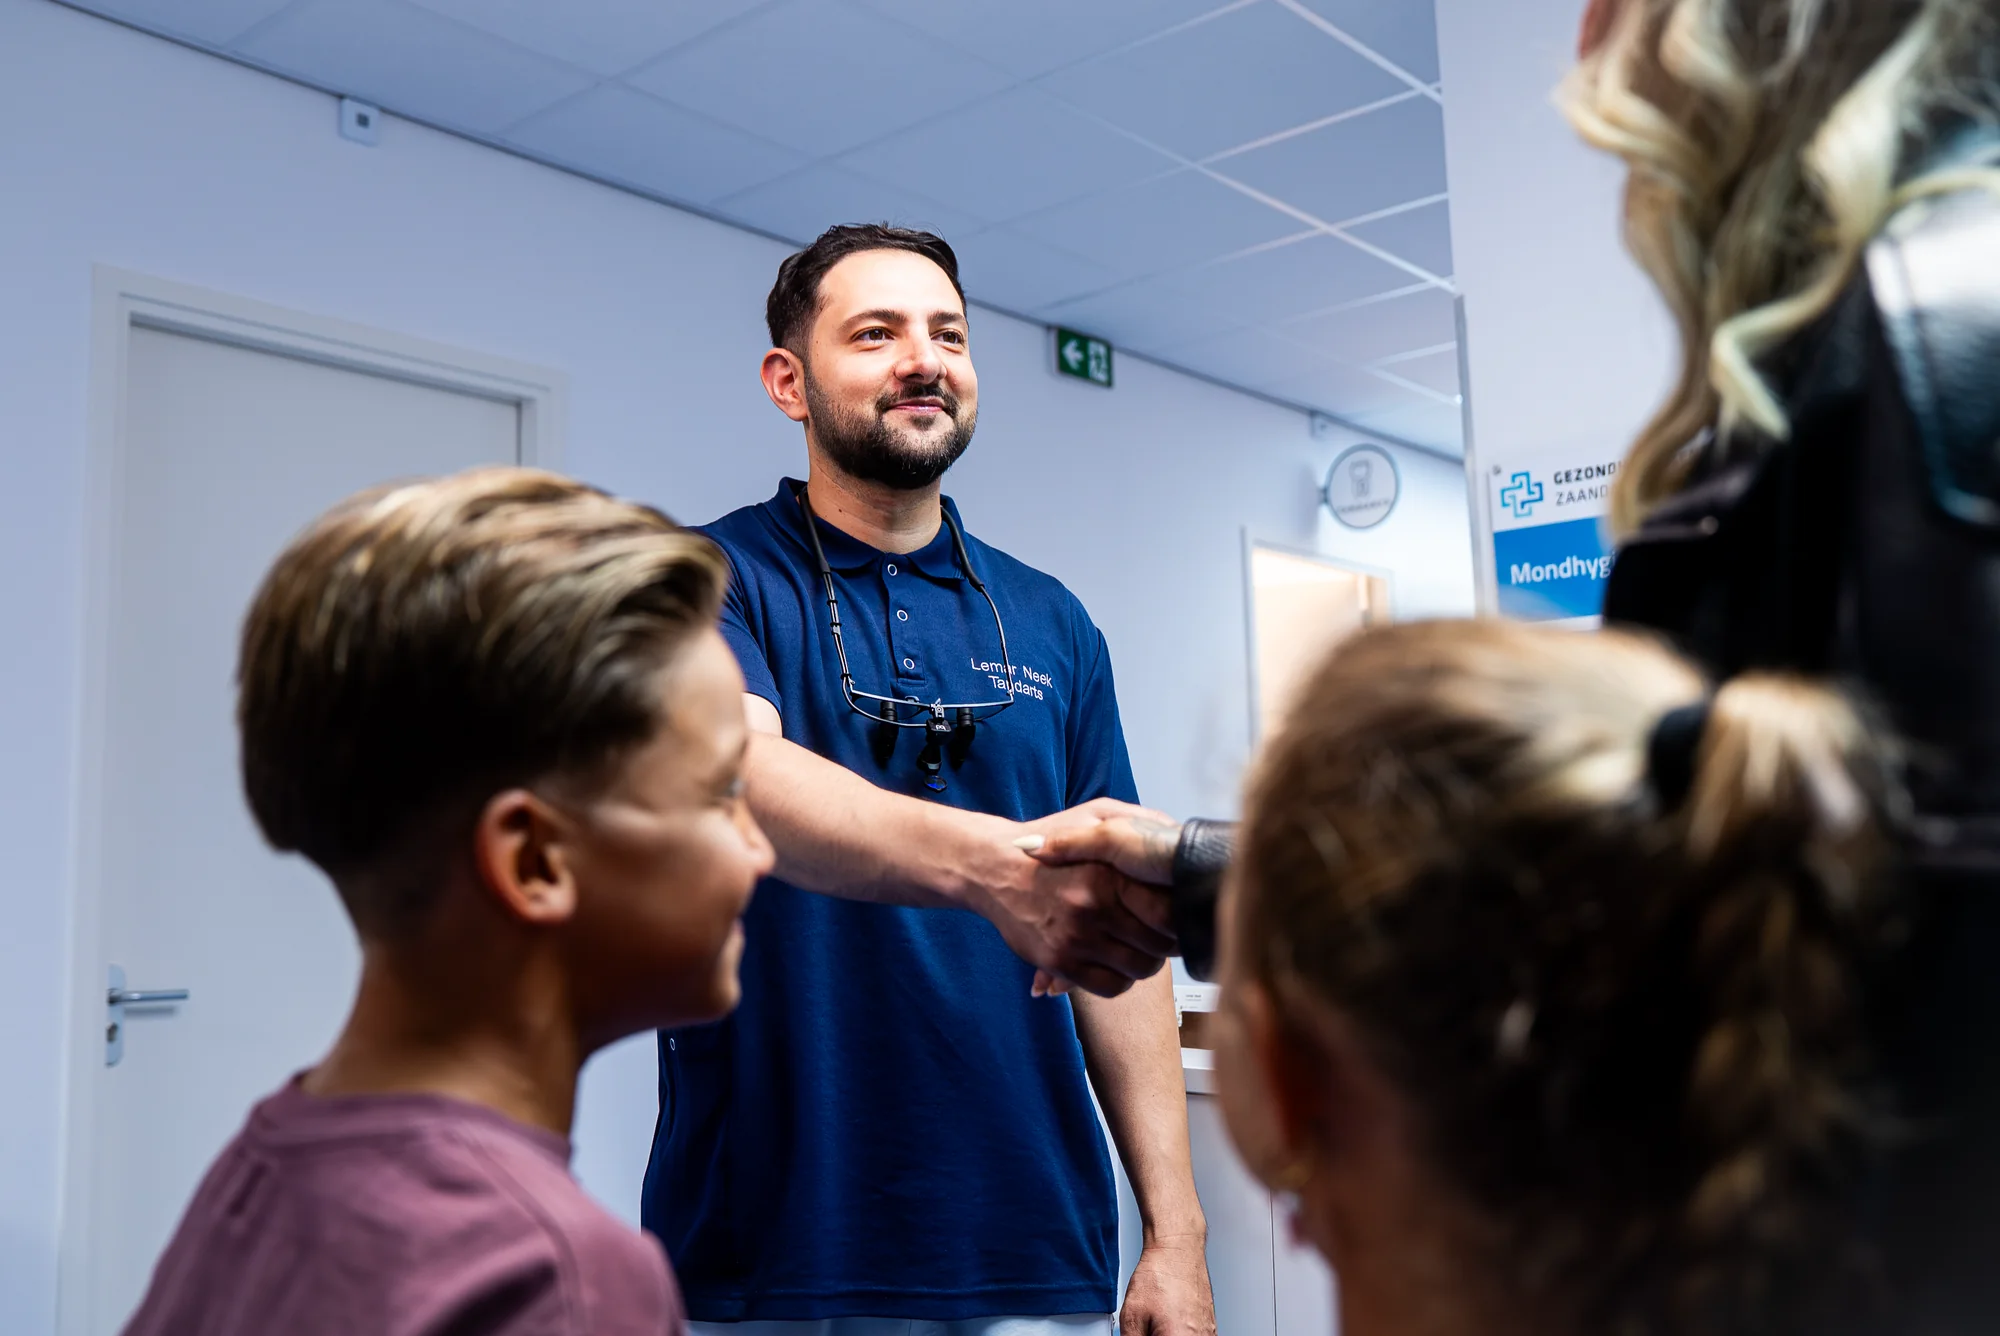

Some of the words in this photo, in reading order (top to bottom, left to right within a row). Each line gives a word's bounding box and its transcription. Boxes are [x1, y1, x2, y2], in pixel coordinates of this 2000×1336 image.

[1554, 461, 1622, 485] GEZOND
[970, 658, 1017, 676] Lemar
[1022, 665, 1053, 688] Neek
